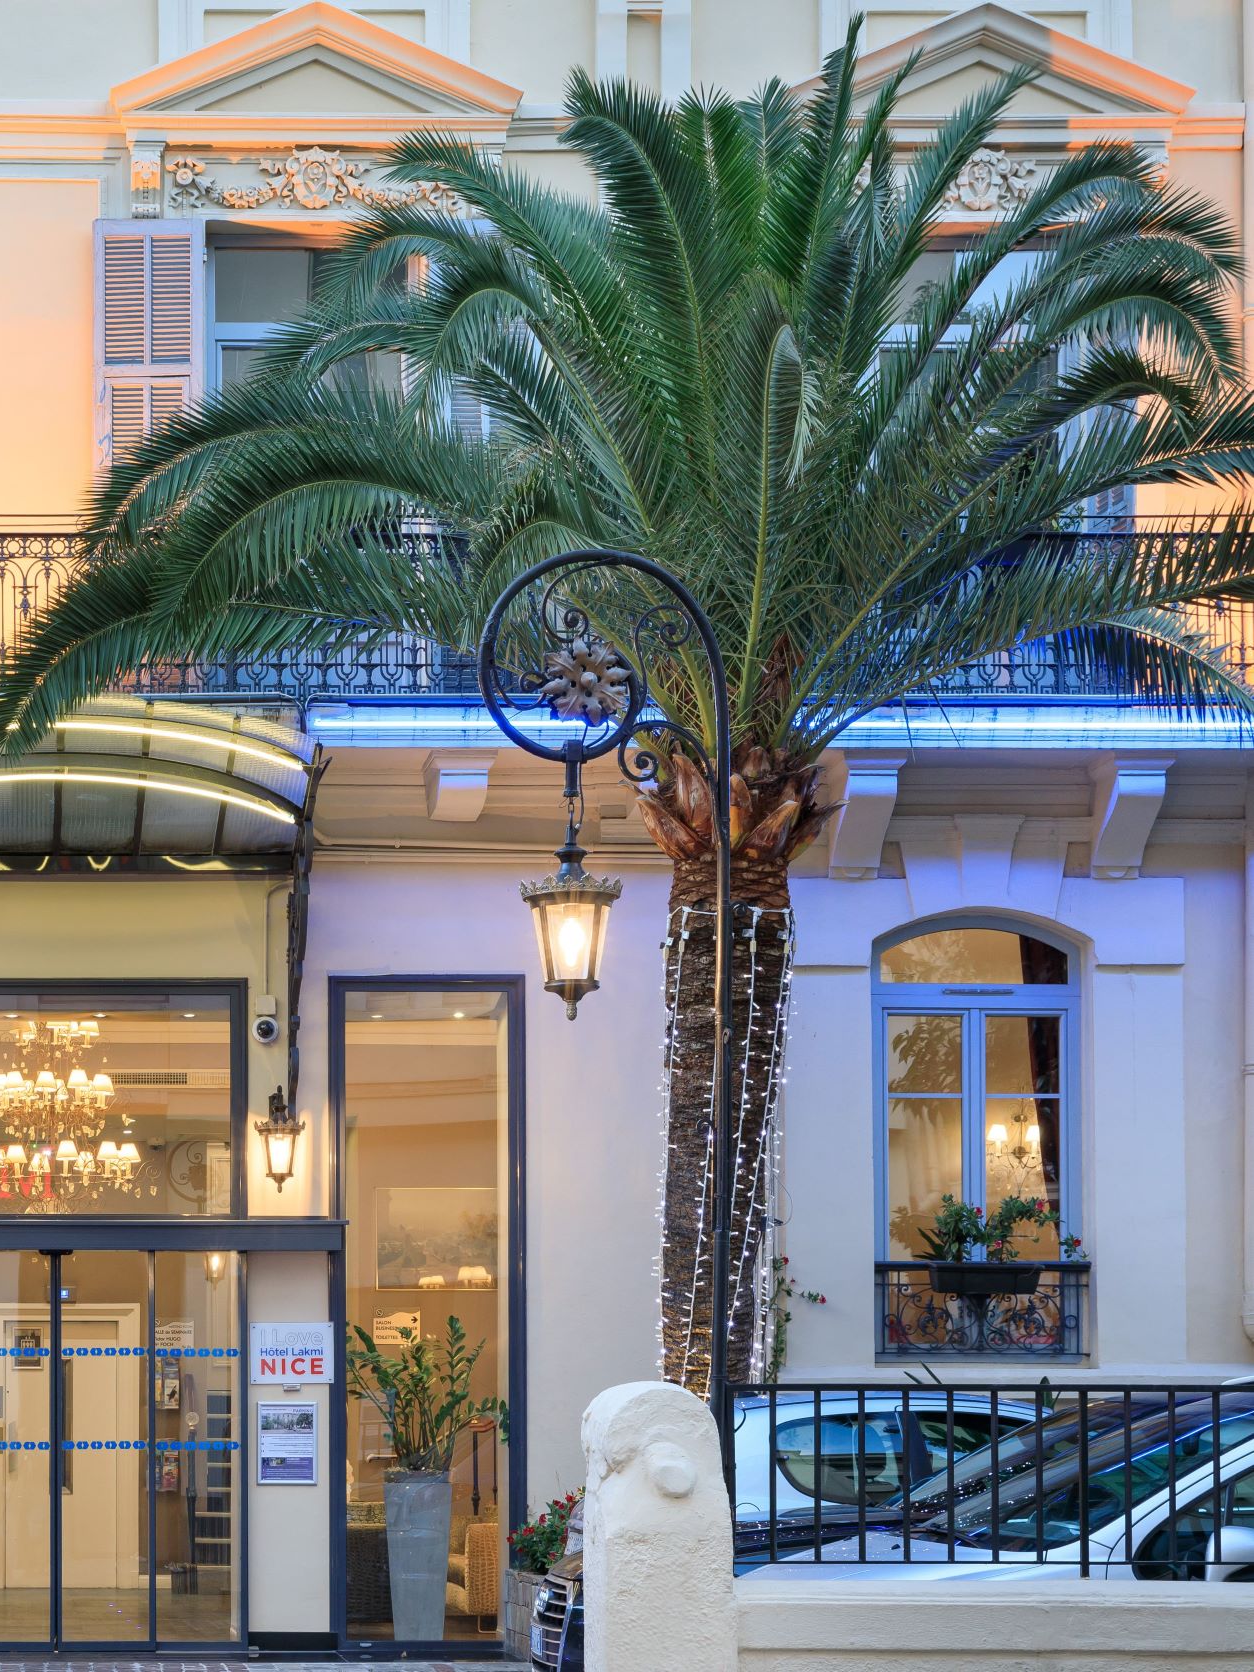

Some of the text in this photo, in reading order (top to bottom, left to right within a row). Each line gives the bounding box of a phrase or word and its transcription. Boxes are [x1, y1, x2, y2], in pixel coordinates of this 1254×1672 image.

[271, 1328, 324, 1347] Love
[260, 1347, 324, 1357] Hôtel Lakmi
[260, 1357, 324, 1376] NICE
